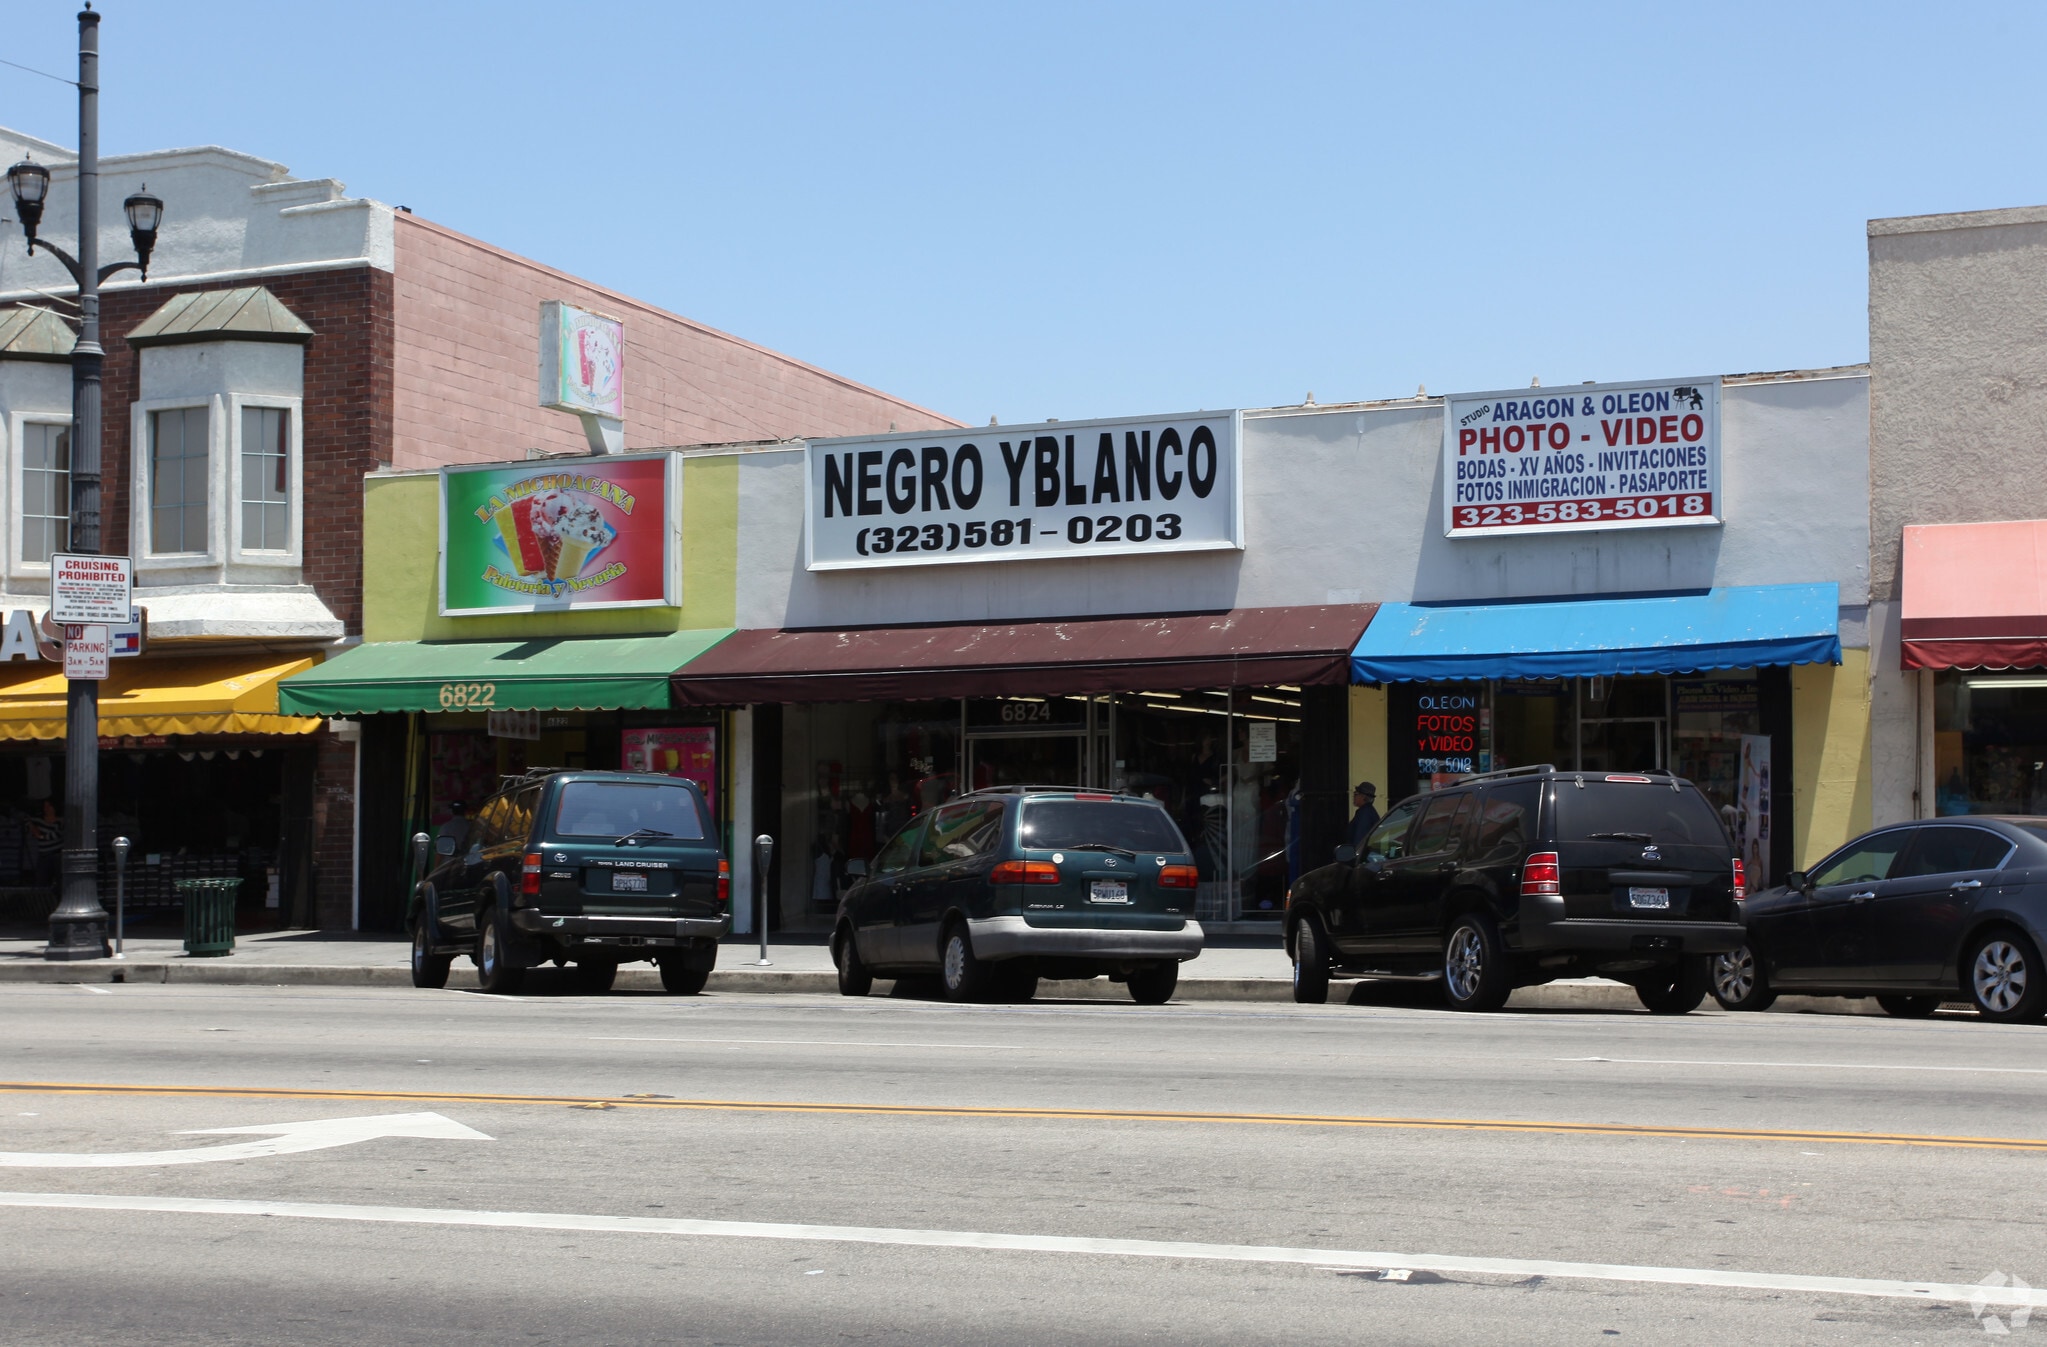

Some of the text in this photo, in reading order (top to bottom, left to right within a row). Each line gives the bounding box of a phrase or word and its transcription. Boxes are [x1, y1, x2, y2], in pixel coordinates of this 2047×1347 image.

[1460, 404, 1490, 427] STUDIO
[1492, 391, 1670, 422] ARAGON & OLEON
[1459, 422, 1571, 456] PHOTO
[1600, 413, 1704, 447] VIDEO
[1457, 458, 1506, 480] BODAS
[1519, 456, 1539, 477] XV
[1544, 451, 1585, 475] AÑOS
[1598, 445, 1707, 472] INVITACIONES
[824, 443, 983, 519] NEGRO
[1457, 480, 1503, 502] FOTOS
[1508, 475, 1606, 500] INMIGRACION
[1619, 469, 1708, 494] PASAPORTE
[474, 473, 636, 524] LA MICHOACANA
[1459, 496, 1705, 526] 323-583-5018
[65, 560, 119, 572] CRUISING
[58, 570, 126, 582] PROHIBITED
[550, 582, 567, 598] y
[67, 625, 82, 639] NO
[68, 643, 105, 653] PARKING
[439, 682, 496, 707] 6822
[1418, 696, 1475, 710] OLEON
[1001, 702, 1051, 722] 6824
[1417, 715, 1475, 732] FOTOS
[1428, 735, 1474, 752] VIDEO
[613, 878, 647, 889] 3PHS770
[1092, 888, 1125, 899] 5PWU168
